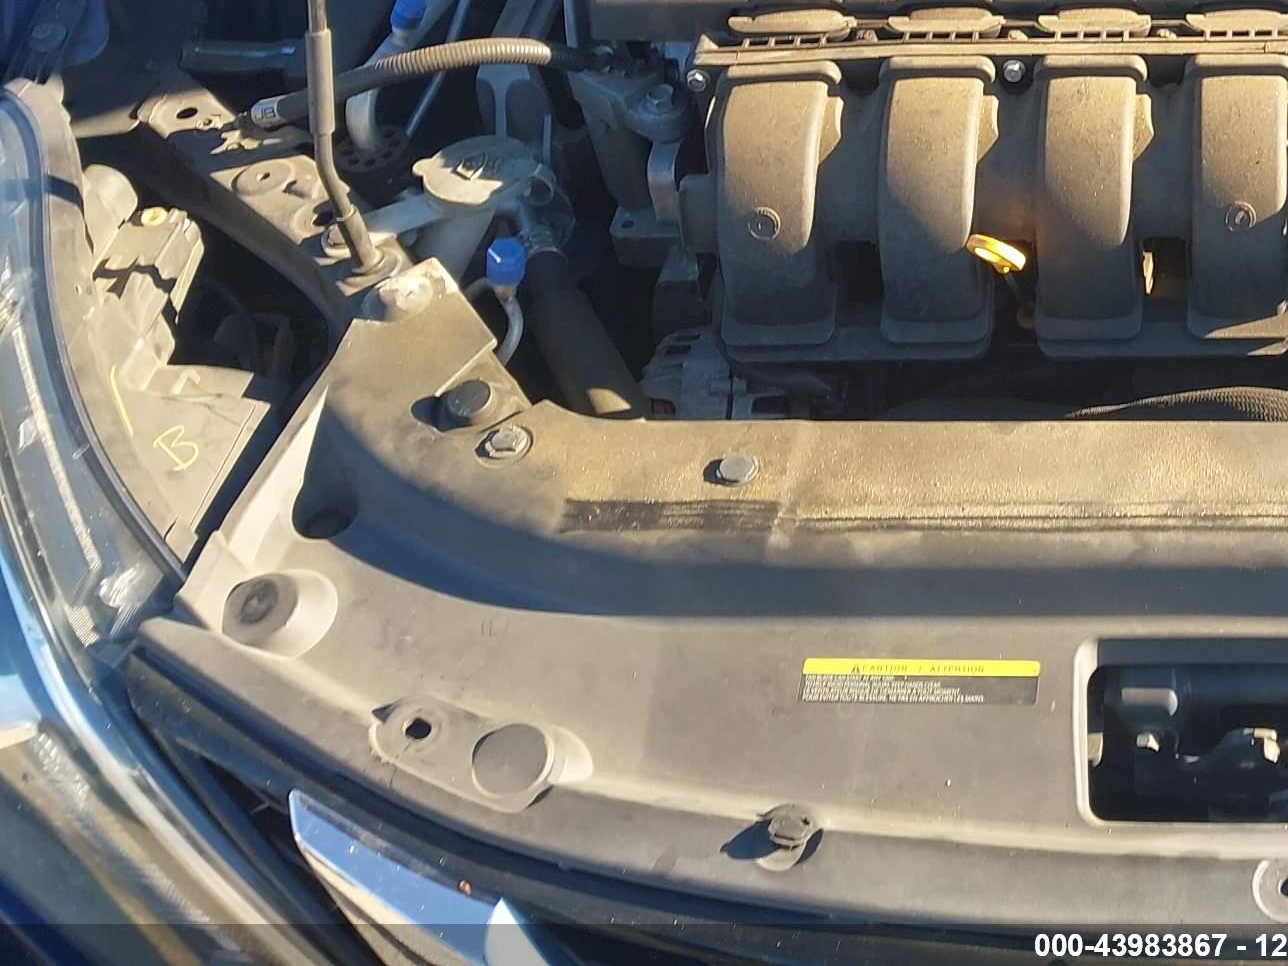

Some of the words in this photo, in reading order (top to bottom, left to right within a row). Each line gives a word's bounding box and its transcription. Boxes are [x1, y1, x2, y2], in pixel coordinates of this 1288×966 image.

[152, 424, 199, 472] B
[862, 664, 908, 674] CAUTION
[929, 665, 986, 675] ATTENTION
